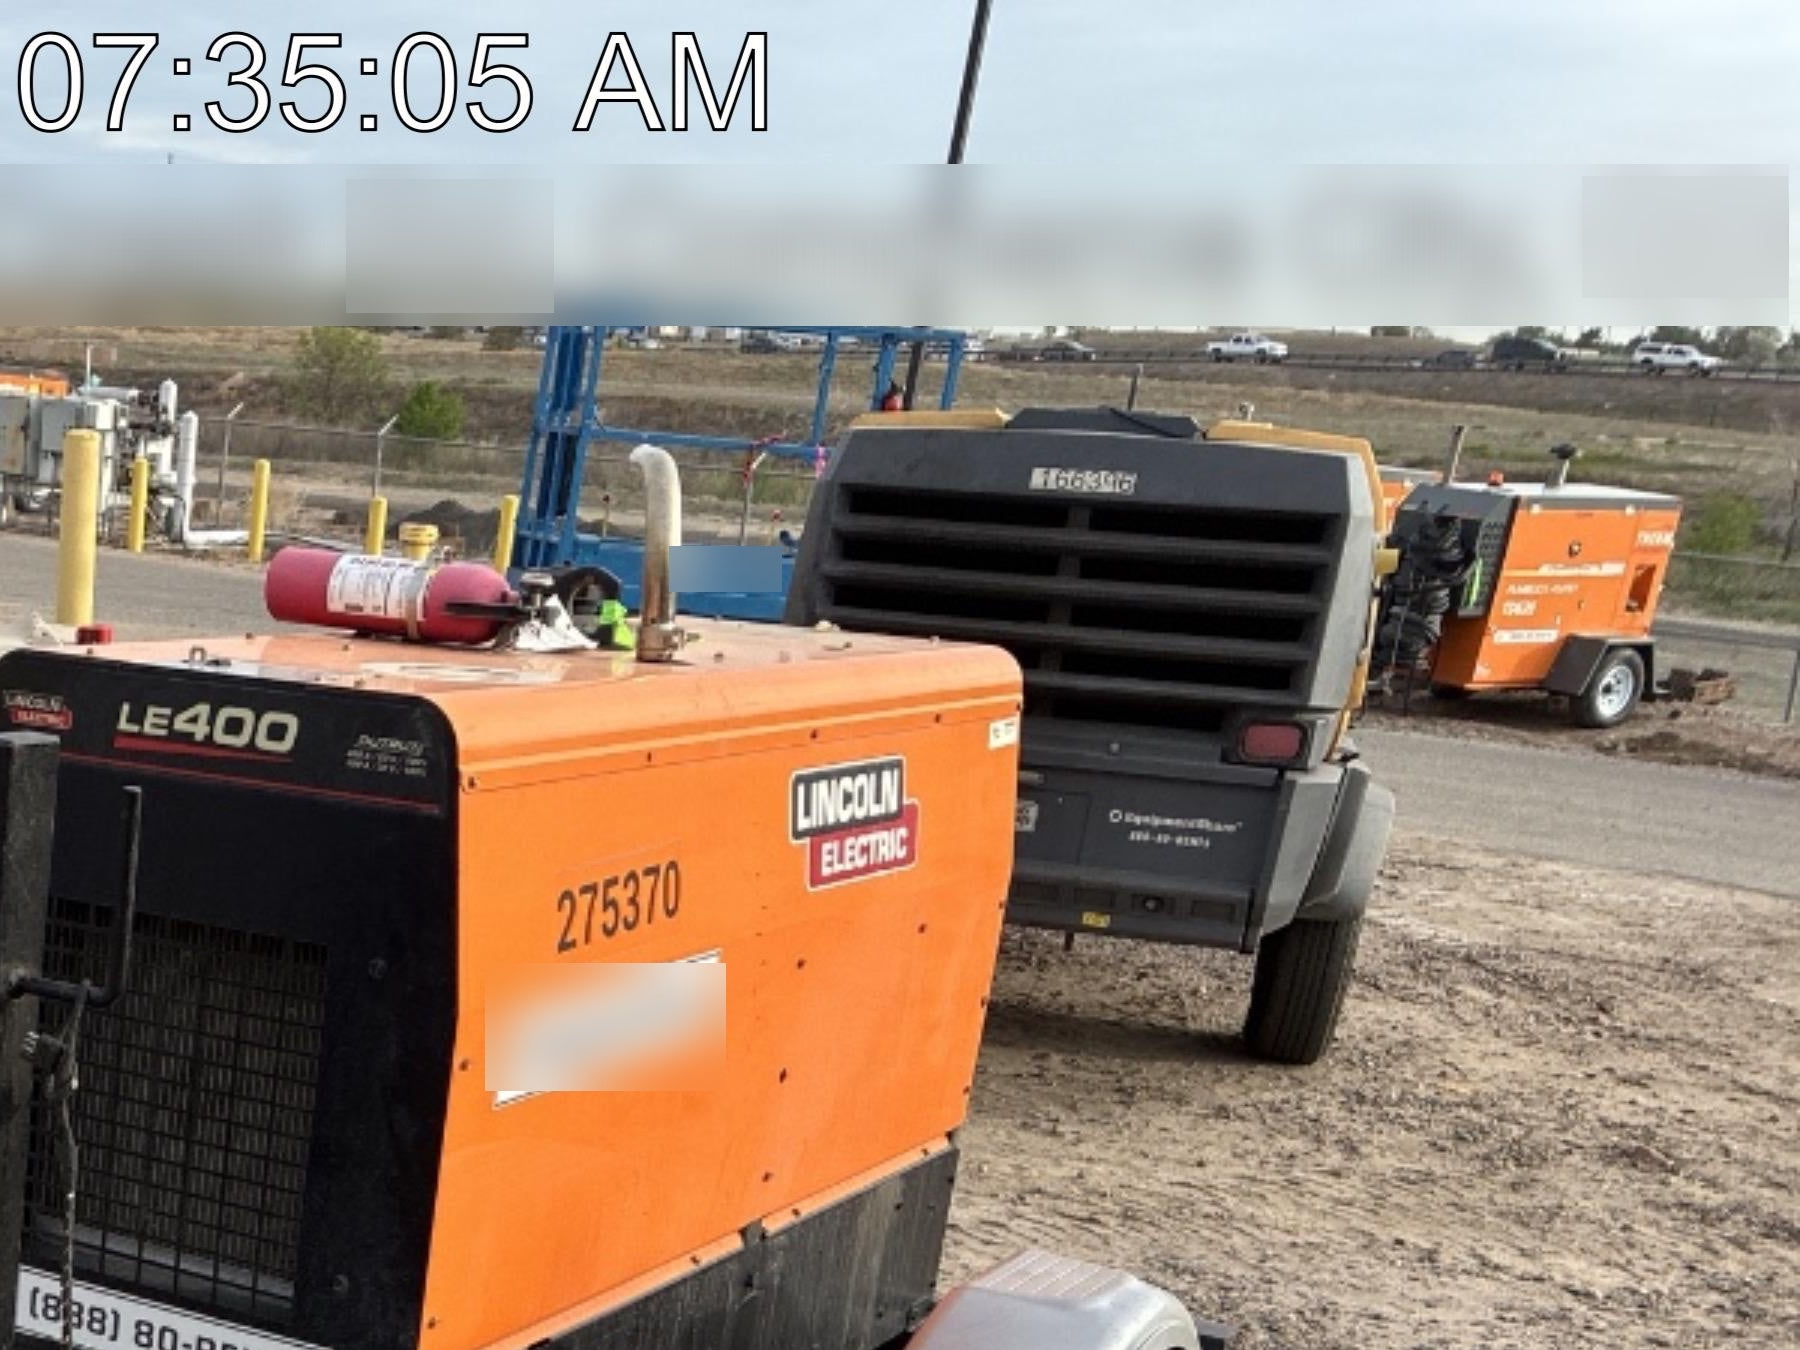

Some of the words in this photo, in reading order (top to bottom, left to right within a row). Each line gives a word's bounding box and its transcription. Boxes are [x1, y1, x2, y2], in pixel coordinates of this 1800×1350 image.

[116, 701, 300, 754] LE400
[797, 767, 899, 832] LINCOLN
[820, 826, 909, 878] ELECTRIC
[557, 859, 680, 954] 275370
